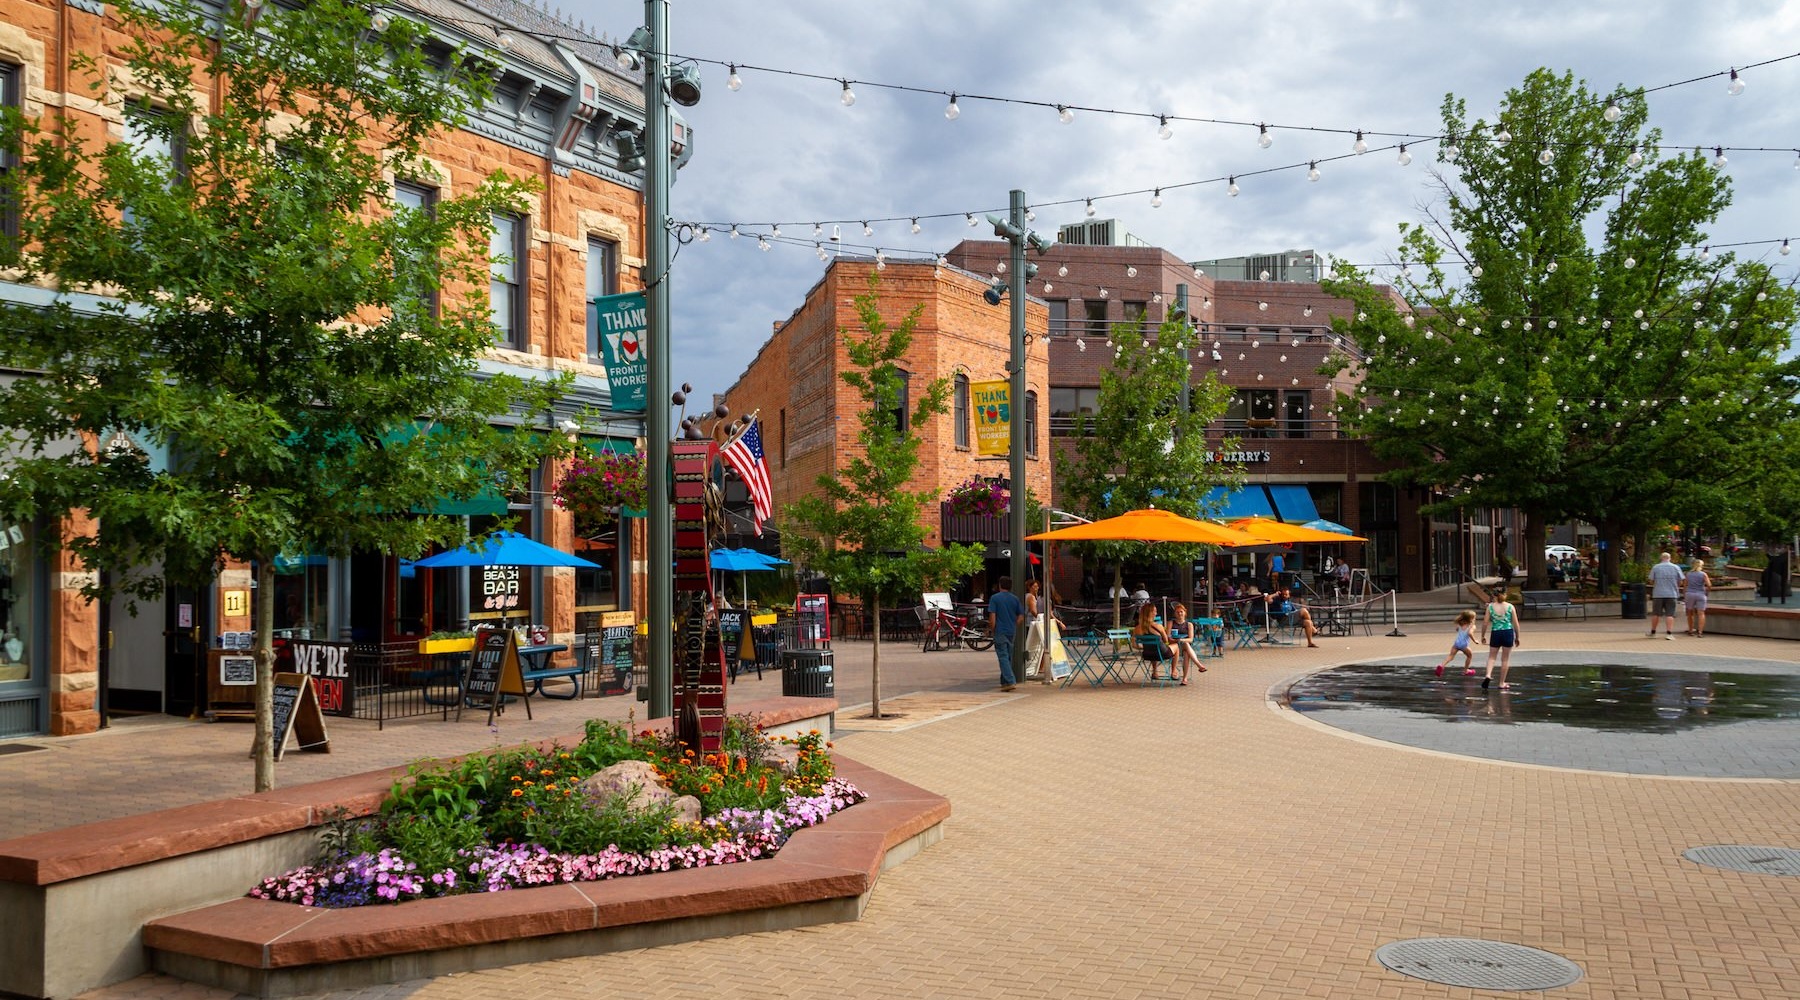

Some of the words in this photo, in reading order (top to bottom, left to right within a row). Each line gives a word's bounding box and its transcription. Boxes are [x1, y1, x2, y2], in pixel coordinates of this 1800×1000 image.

[610, 365, 638, 376] FRONT
[611, 374, 647, 387] WORKE
[975, 390, 1008, 402] THANK
[976, 404, 1010, 424] YOU
[111, 440, 130, 448] OLD
[1223, 450, 1270, 462] JERRY'S
[484, 571, 519, 580] BEACH
[484, 581, 519, 595] BAR
[227, 597, 240, 611] 11
[720, 613, 741, 621] JACK
[293, 644, 349, 678] WE'RE
